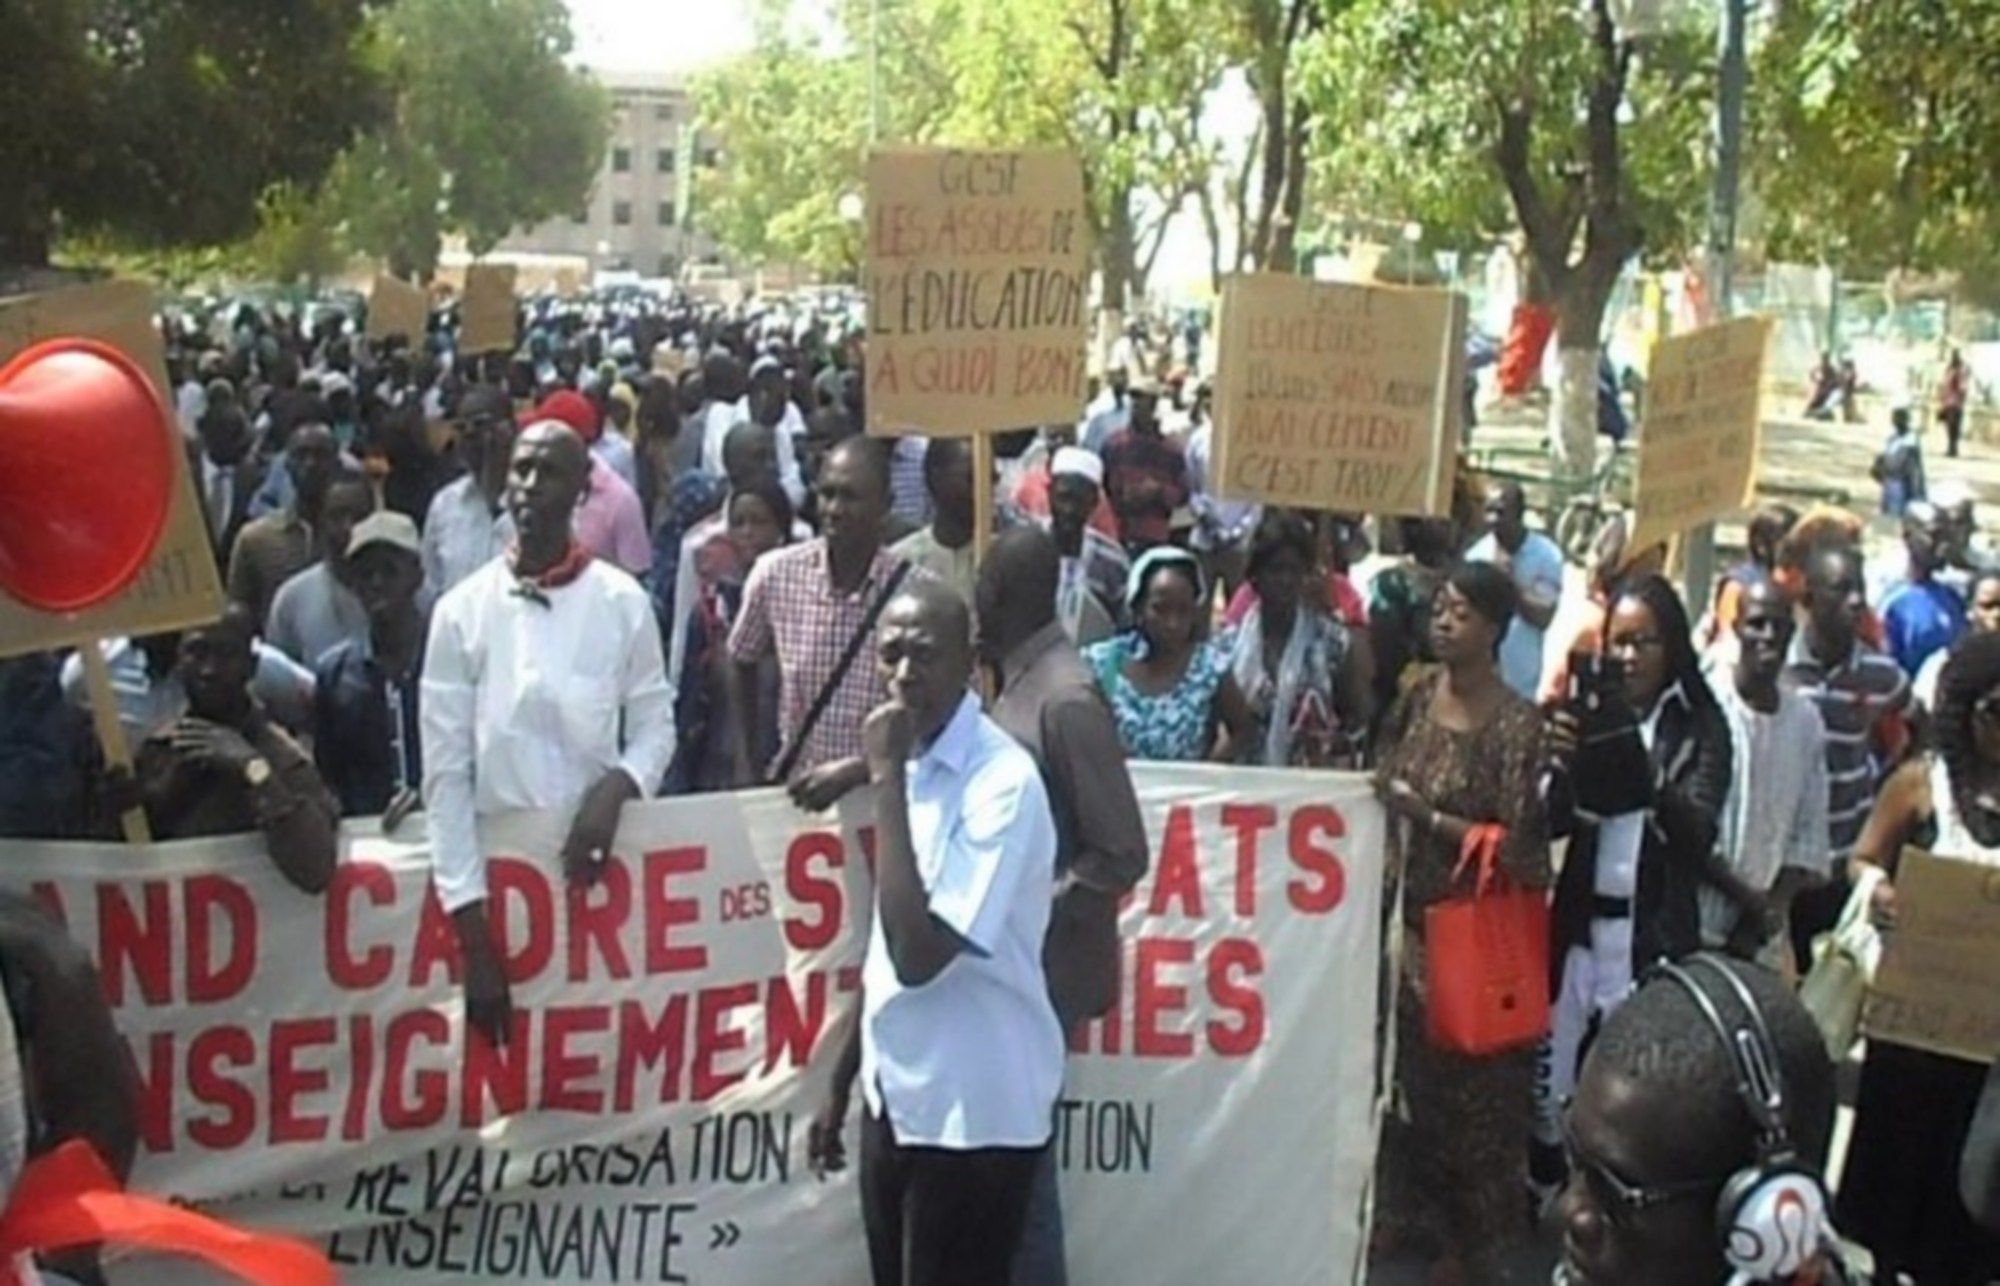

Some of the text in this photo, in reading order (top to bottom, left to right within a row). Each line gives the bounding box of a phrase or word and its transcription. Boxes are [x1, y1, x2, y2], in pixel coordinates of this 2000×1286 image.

[875, 204, 925, 257] LES
[911, 338, 996, 397] QUOI
[325, 846, 708, 991] CADRE
[720, 882, 771, 922] DES
[329, 1197, 697, 1284] ENSEIGNANTE
